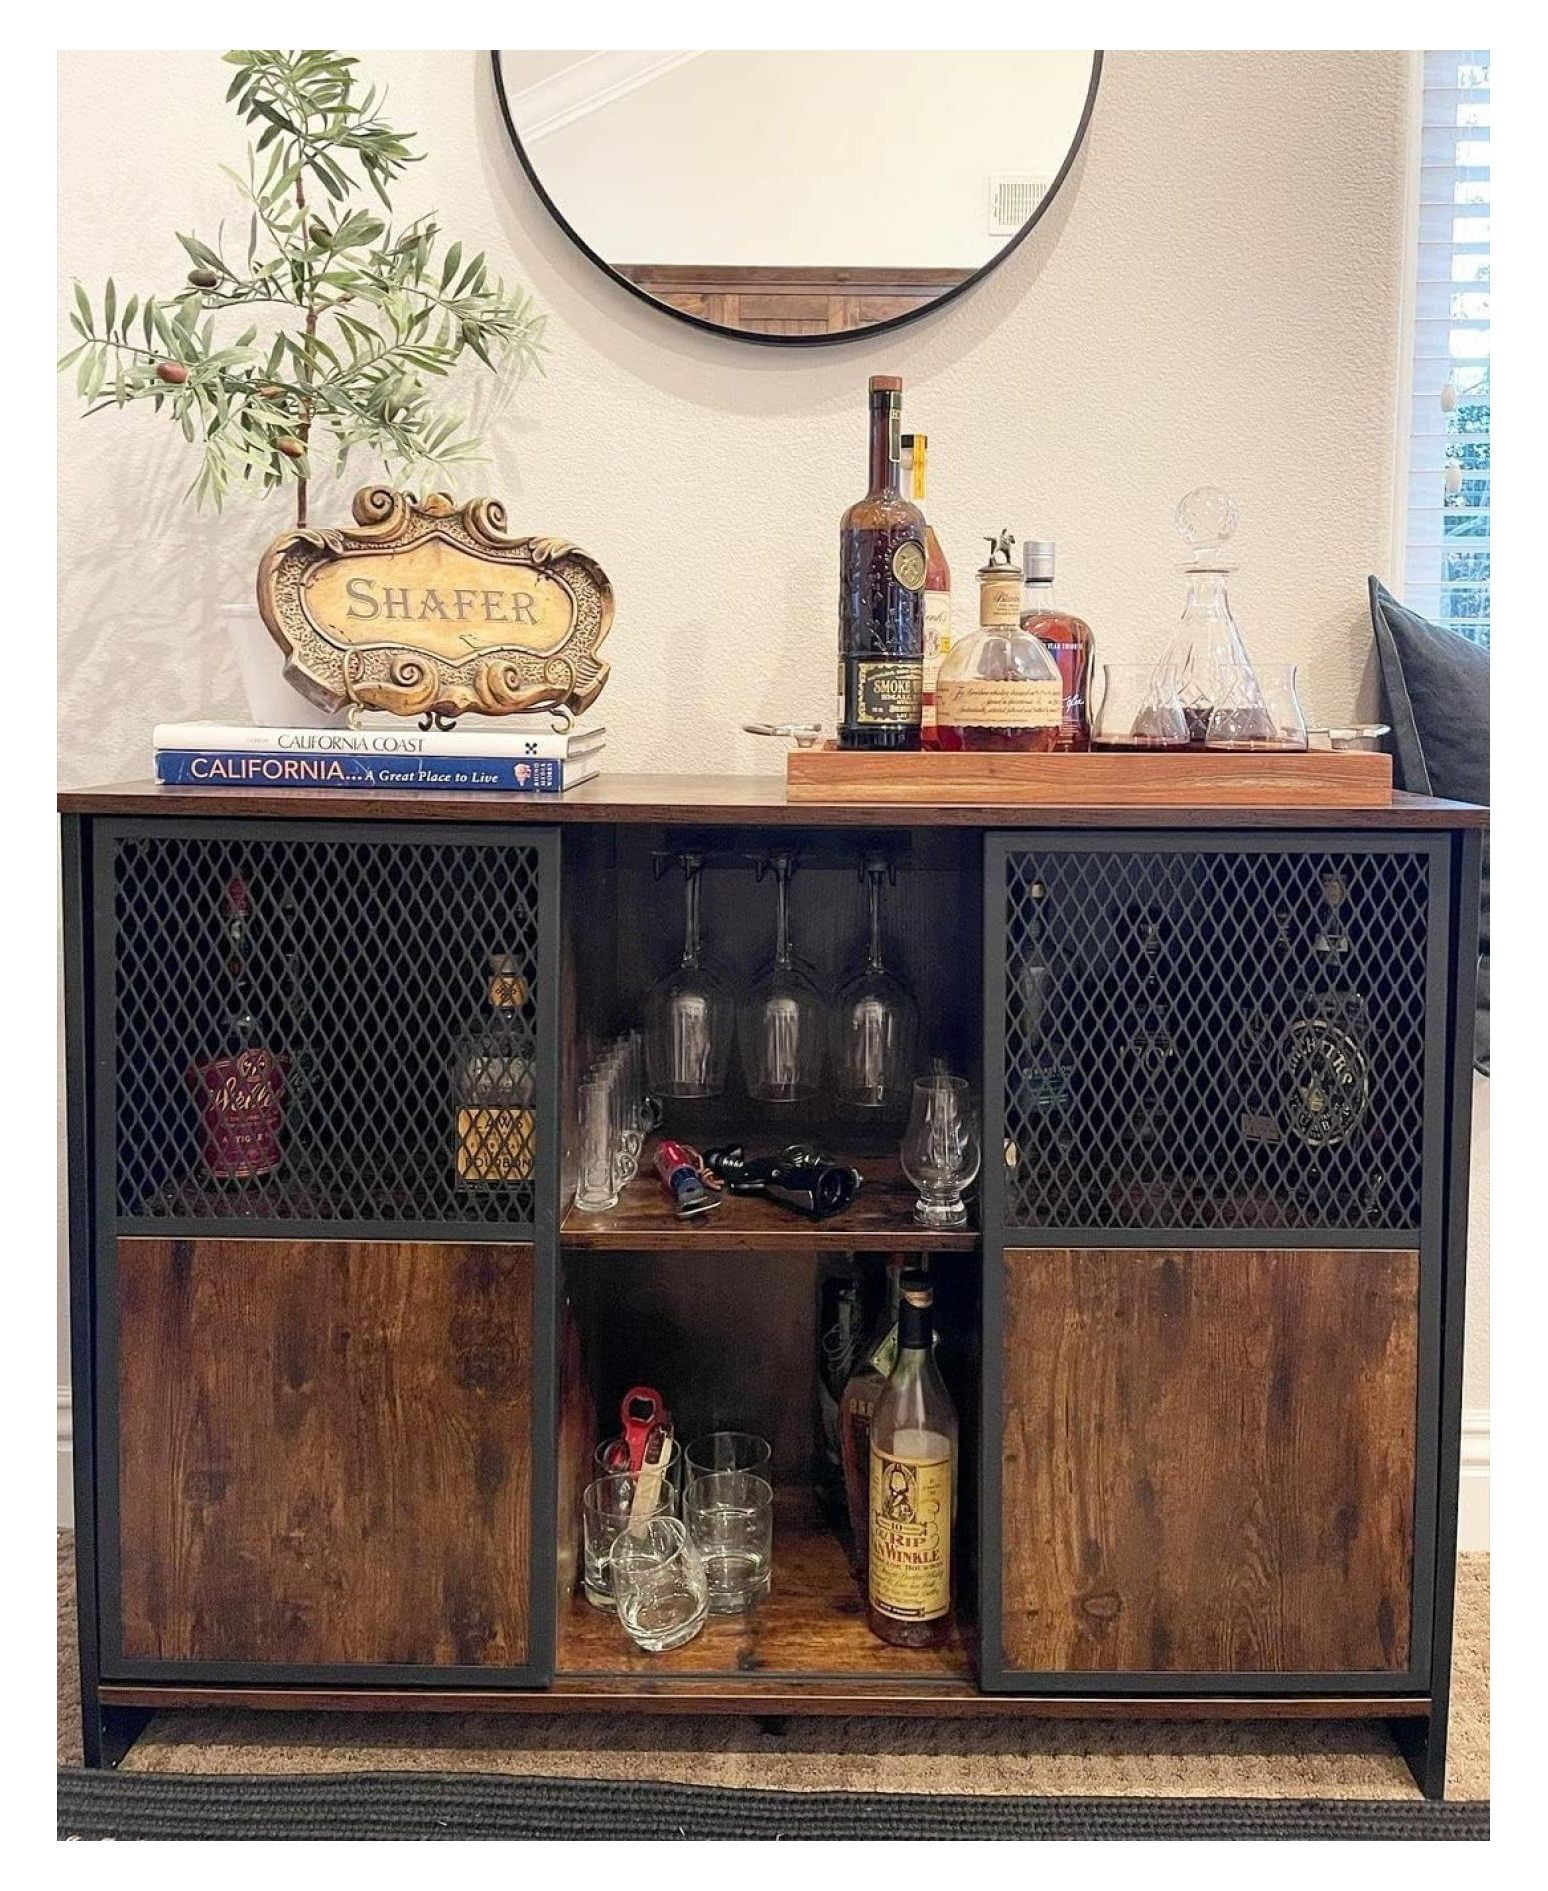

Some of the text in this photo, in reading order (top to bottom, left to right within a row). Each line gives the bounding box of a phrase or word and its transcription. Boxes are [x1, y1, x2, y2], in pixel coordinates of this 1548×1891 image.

[345, 577, 539, 625] SHAFER
[873, 680, 911, 694] SMOKE
[278, 734, 368, 752] CALIFORNIA
[373, 737, 424, 753] COAST
[365, 769, 374, 782] A
[378, 769, 415, 782] Great
[418, 770, 451, 783] Place
[454, 772, 468, 783] to
[471, 771, 499, 784] Live
[891, 1522, 903, 1531] 10
[889, 1533, 927, 1547] RIP
[885, 1542, 940, 1564] WINKLE
